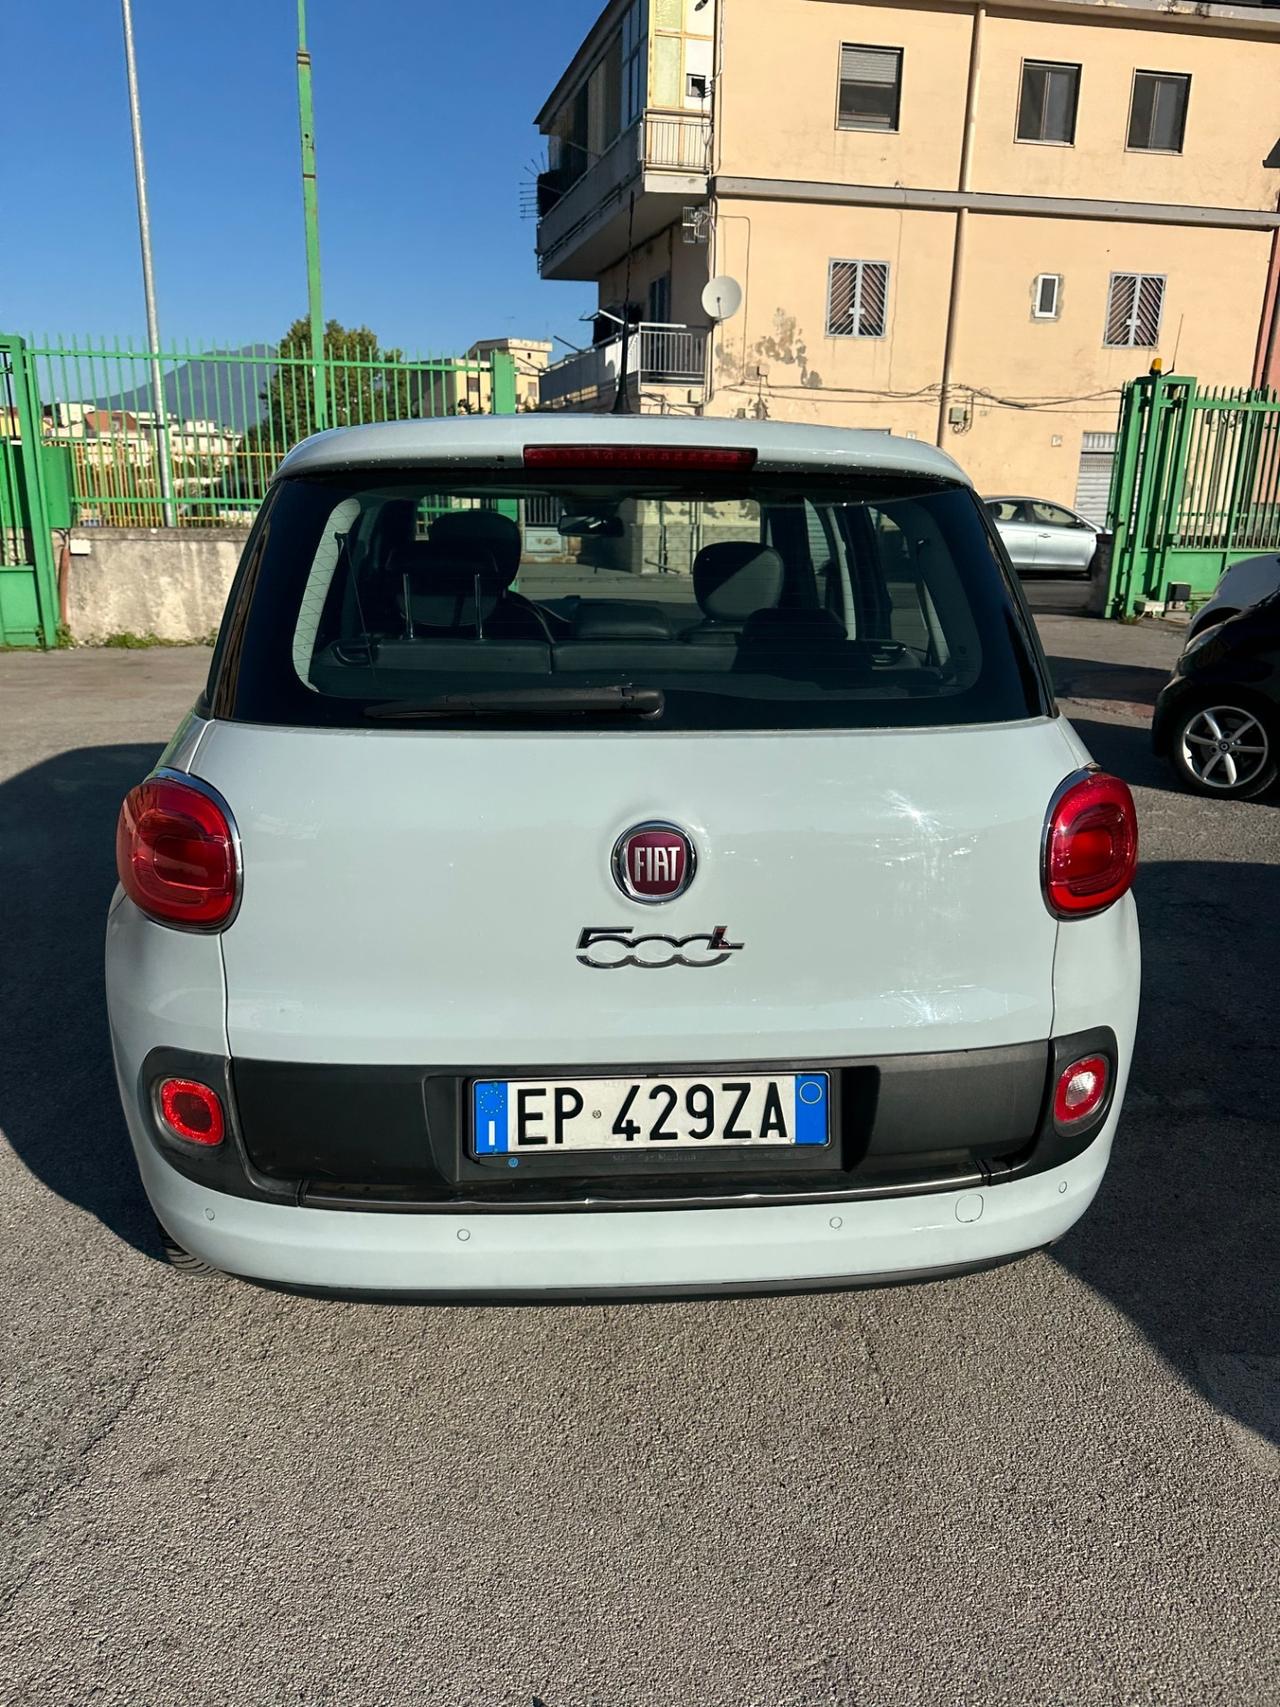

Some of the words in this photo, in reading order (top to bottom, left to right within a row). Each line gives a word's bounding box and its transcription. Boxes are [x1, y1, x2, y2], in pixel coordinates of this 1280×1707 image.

[634, 846, 681, 882] FIAT
[517, 1086, 584, 1146] EP
[612, 1081, 787, 1142] 429ZA
